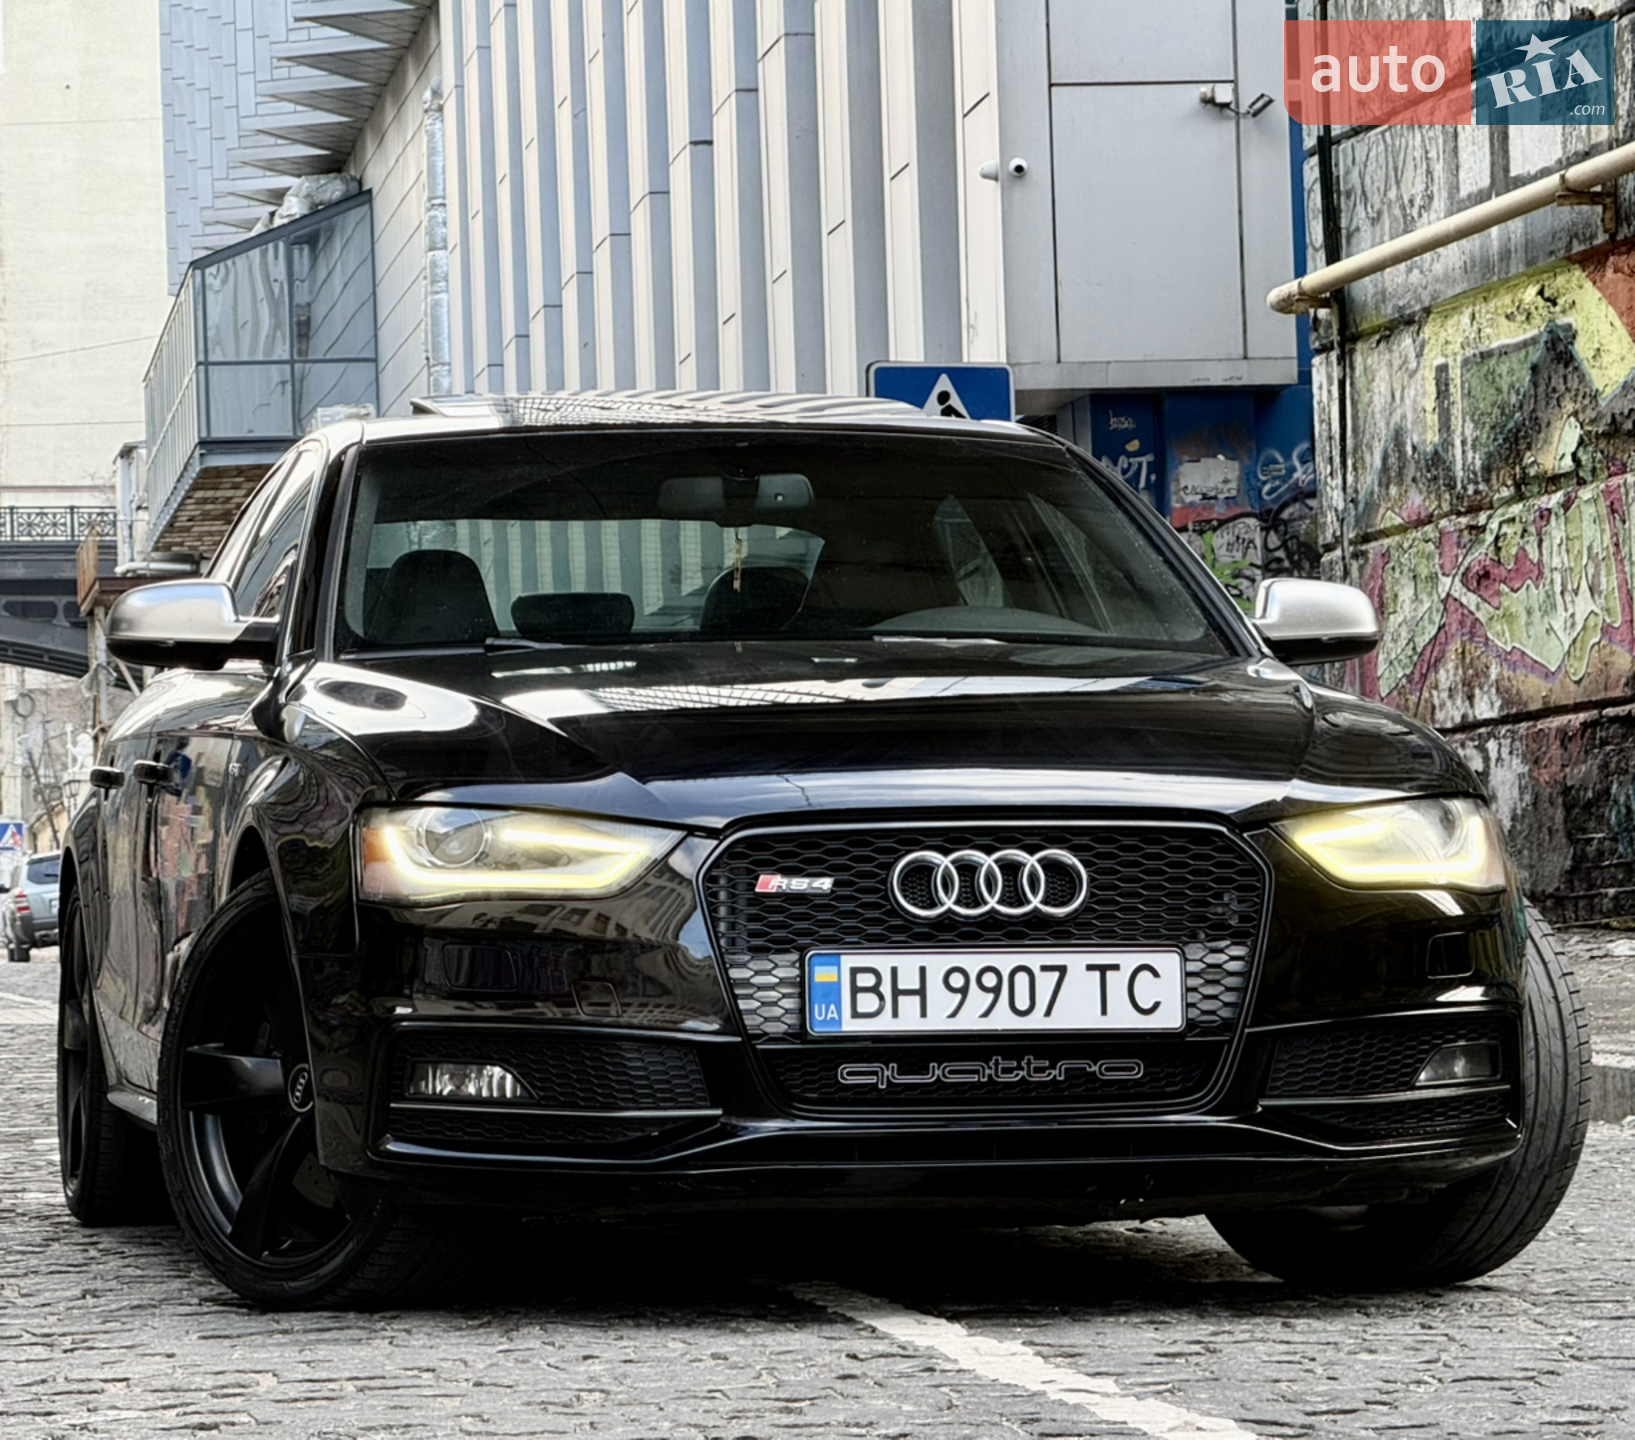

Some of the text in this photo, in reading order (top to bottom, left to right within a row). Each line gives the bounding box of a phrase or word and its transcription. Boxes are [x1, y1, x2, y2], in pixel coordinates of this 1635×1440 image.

[767, 877, 833, 891] RS4
[849, 963, 1163, 1019] BH 9907 TC
[814, 1004, 839, 1021] UA
[838, 1056, 1144, 1089] quattro
